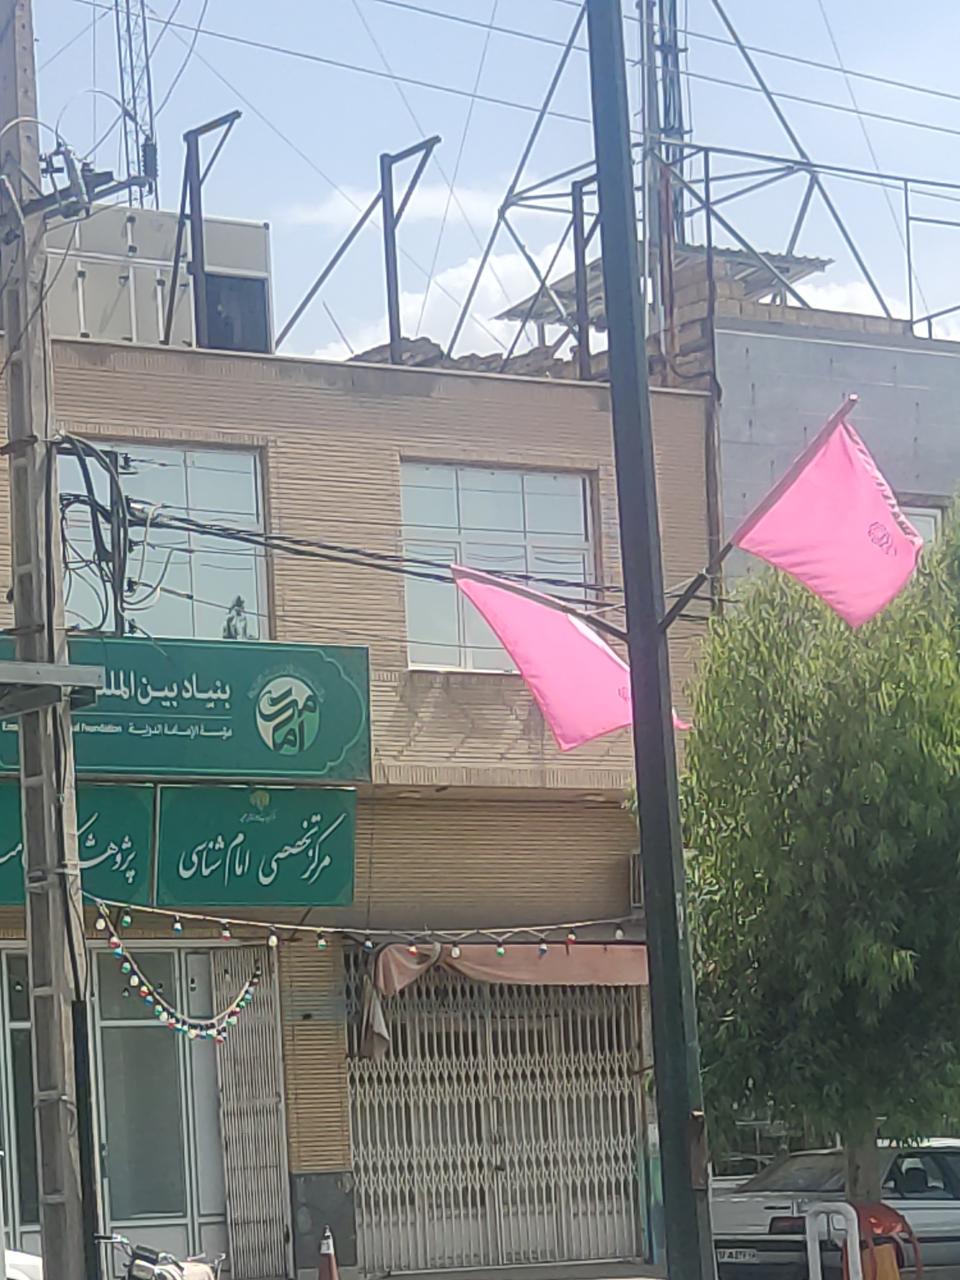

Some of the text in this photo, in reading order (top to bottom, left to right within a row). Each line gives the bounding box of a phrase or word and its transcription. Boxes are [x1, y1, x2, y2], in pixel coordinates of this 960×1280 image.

[137, 676, 178, 708] بین
[181, 672, 231, 709] بنیاد
[178, 835, 226, 879] شناسی
[224, 832, 251, 887] امام
[300, 812, 347, 885] مرکز
